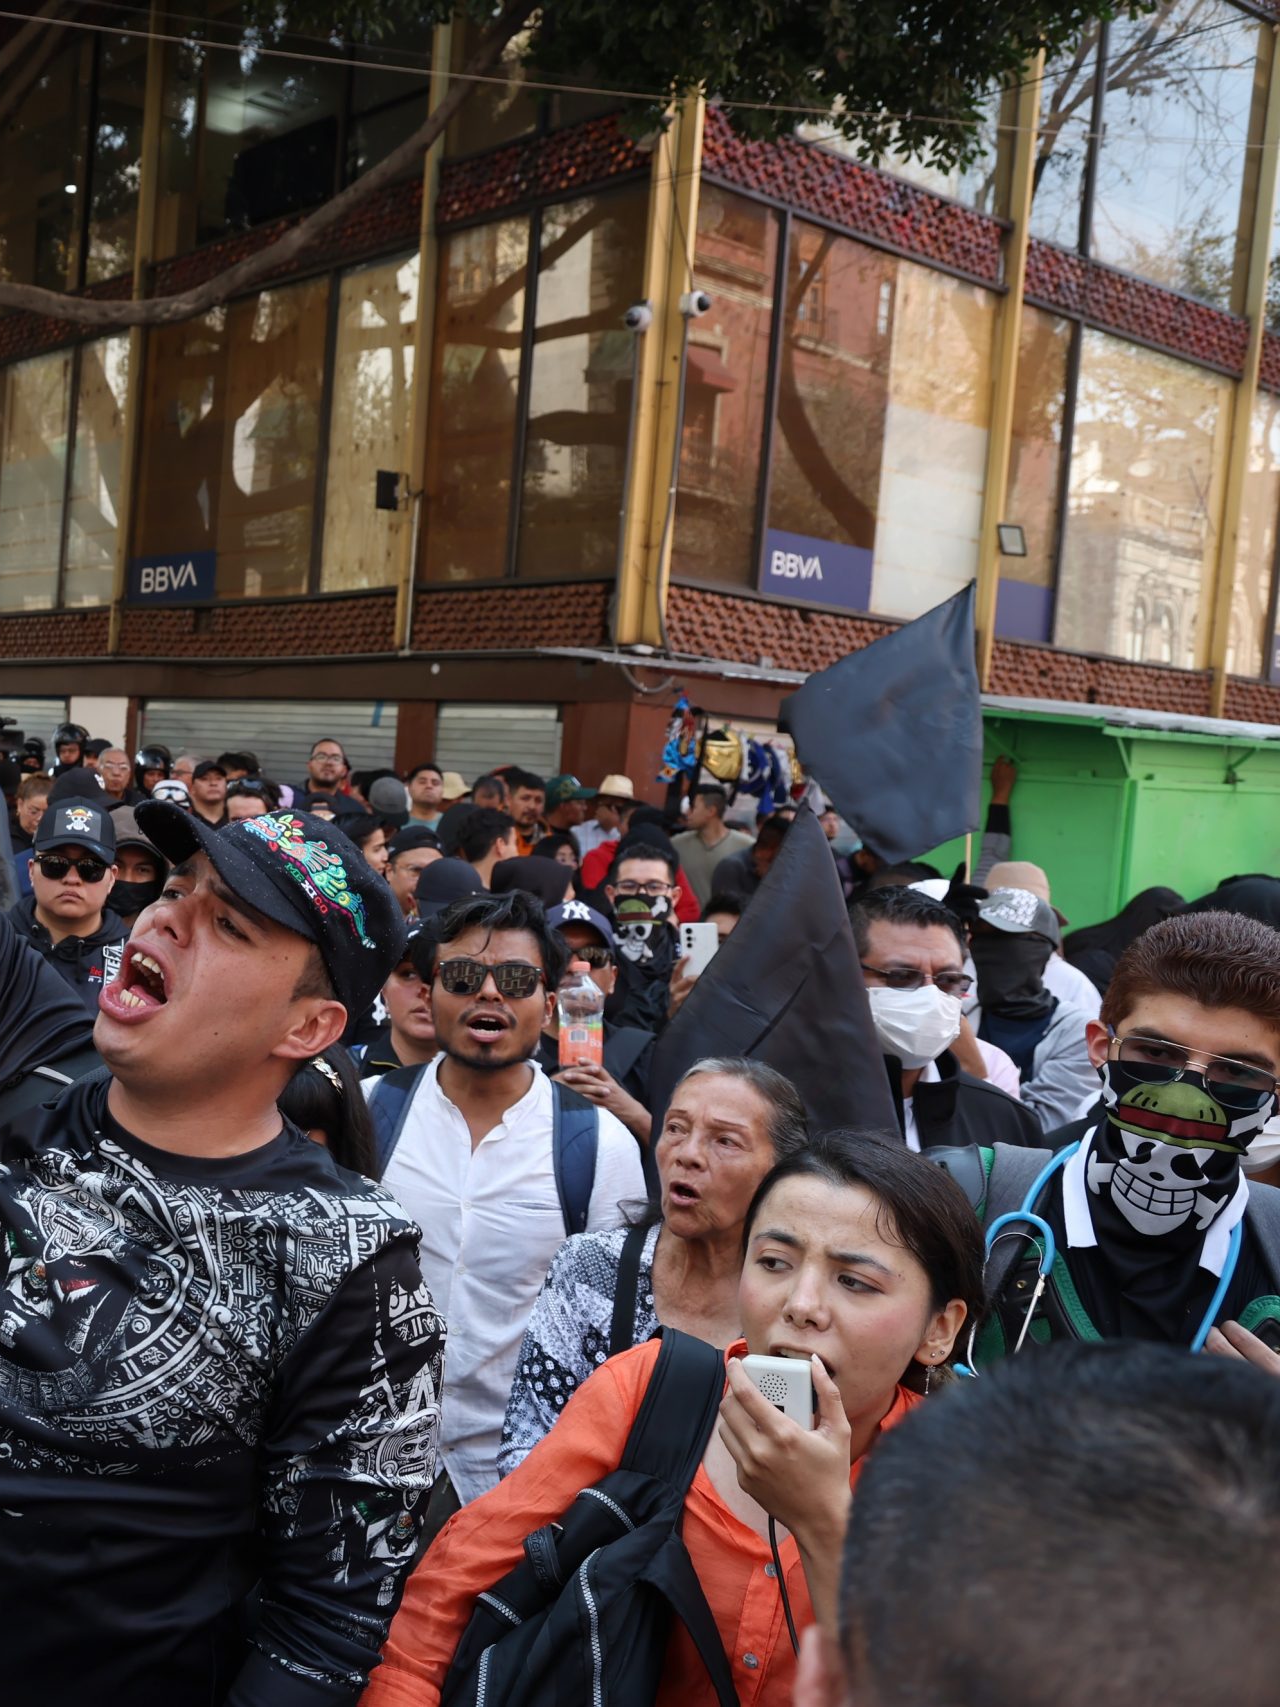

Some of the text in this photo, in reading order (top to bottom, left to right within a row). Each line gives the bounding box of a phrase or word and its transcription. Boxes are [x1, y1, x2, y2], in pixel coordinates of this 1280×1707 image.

[140, 561, 197, 593] BBVA
[771, 550, 823, 580] BBVA
[284, 862, 329, 915] MEXICO
[562, 900, 591, 920] NY
